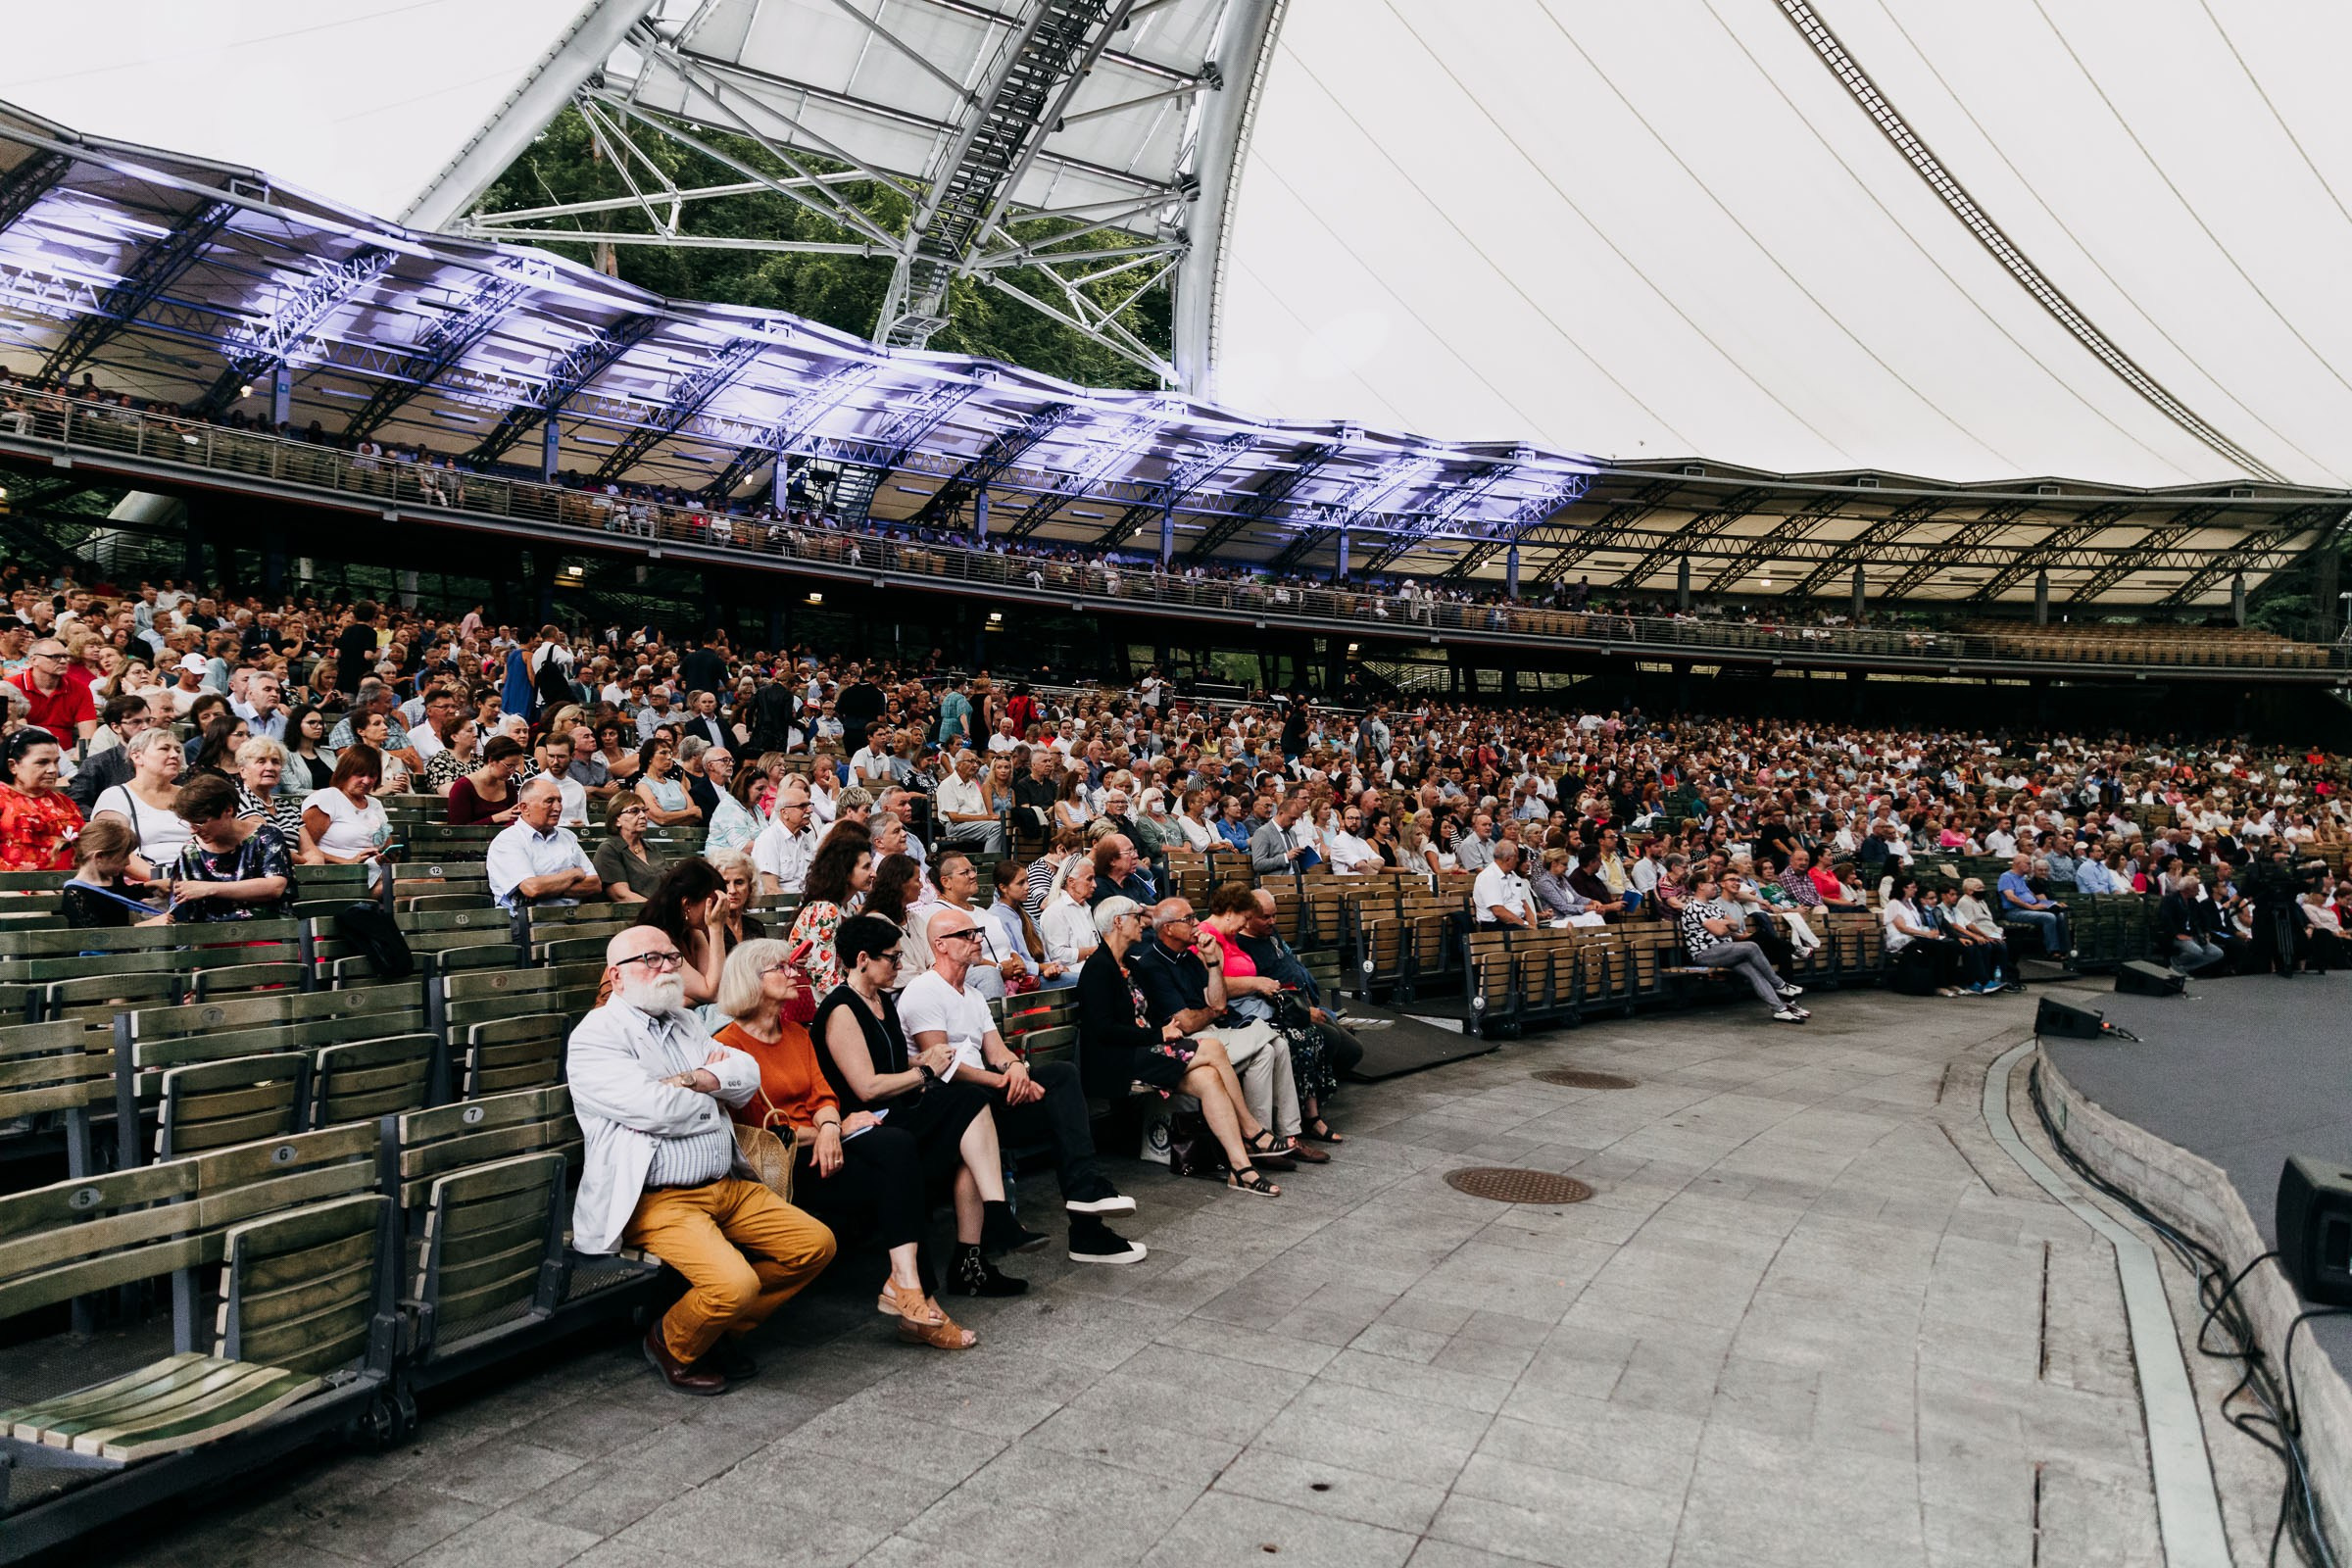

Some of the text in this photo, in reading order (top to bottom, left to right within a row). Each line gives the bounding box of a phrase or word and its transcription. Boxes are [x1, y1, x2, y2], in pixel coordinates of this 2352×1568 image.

[209, 1009, 217, 1020] 7
[469, 1108, 477, 1121] 7
[278, 1148, 288, 1160] 6
[79, 1191, 90, 1205] 5
